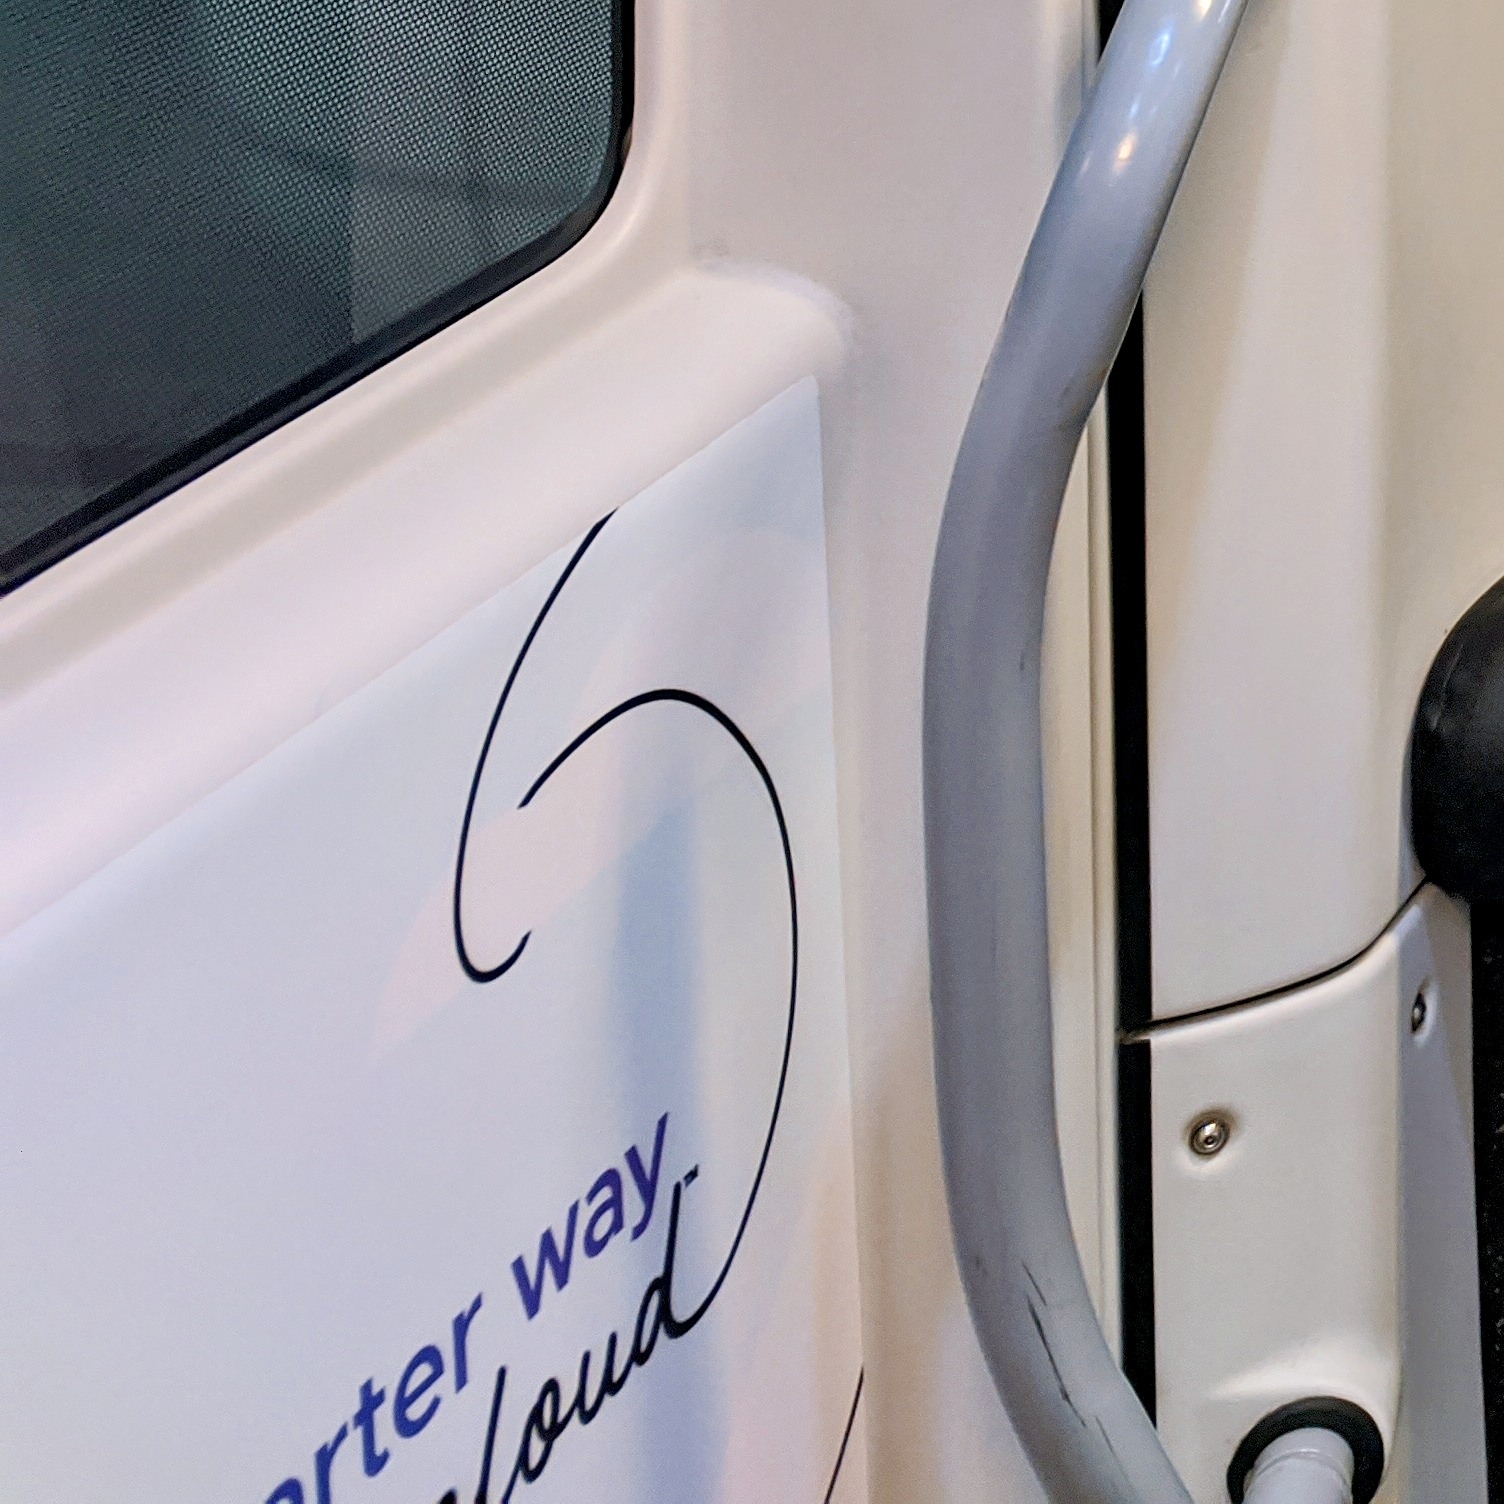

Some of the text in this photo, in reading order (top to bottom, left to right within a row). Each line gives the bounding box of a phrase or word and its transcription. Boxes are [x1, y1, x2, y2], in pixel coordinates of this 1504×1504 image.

[265, 1111, 669, 1504] rter way
[437, 1180, 692, 1504] loud
